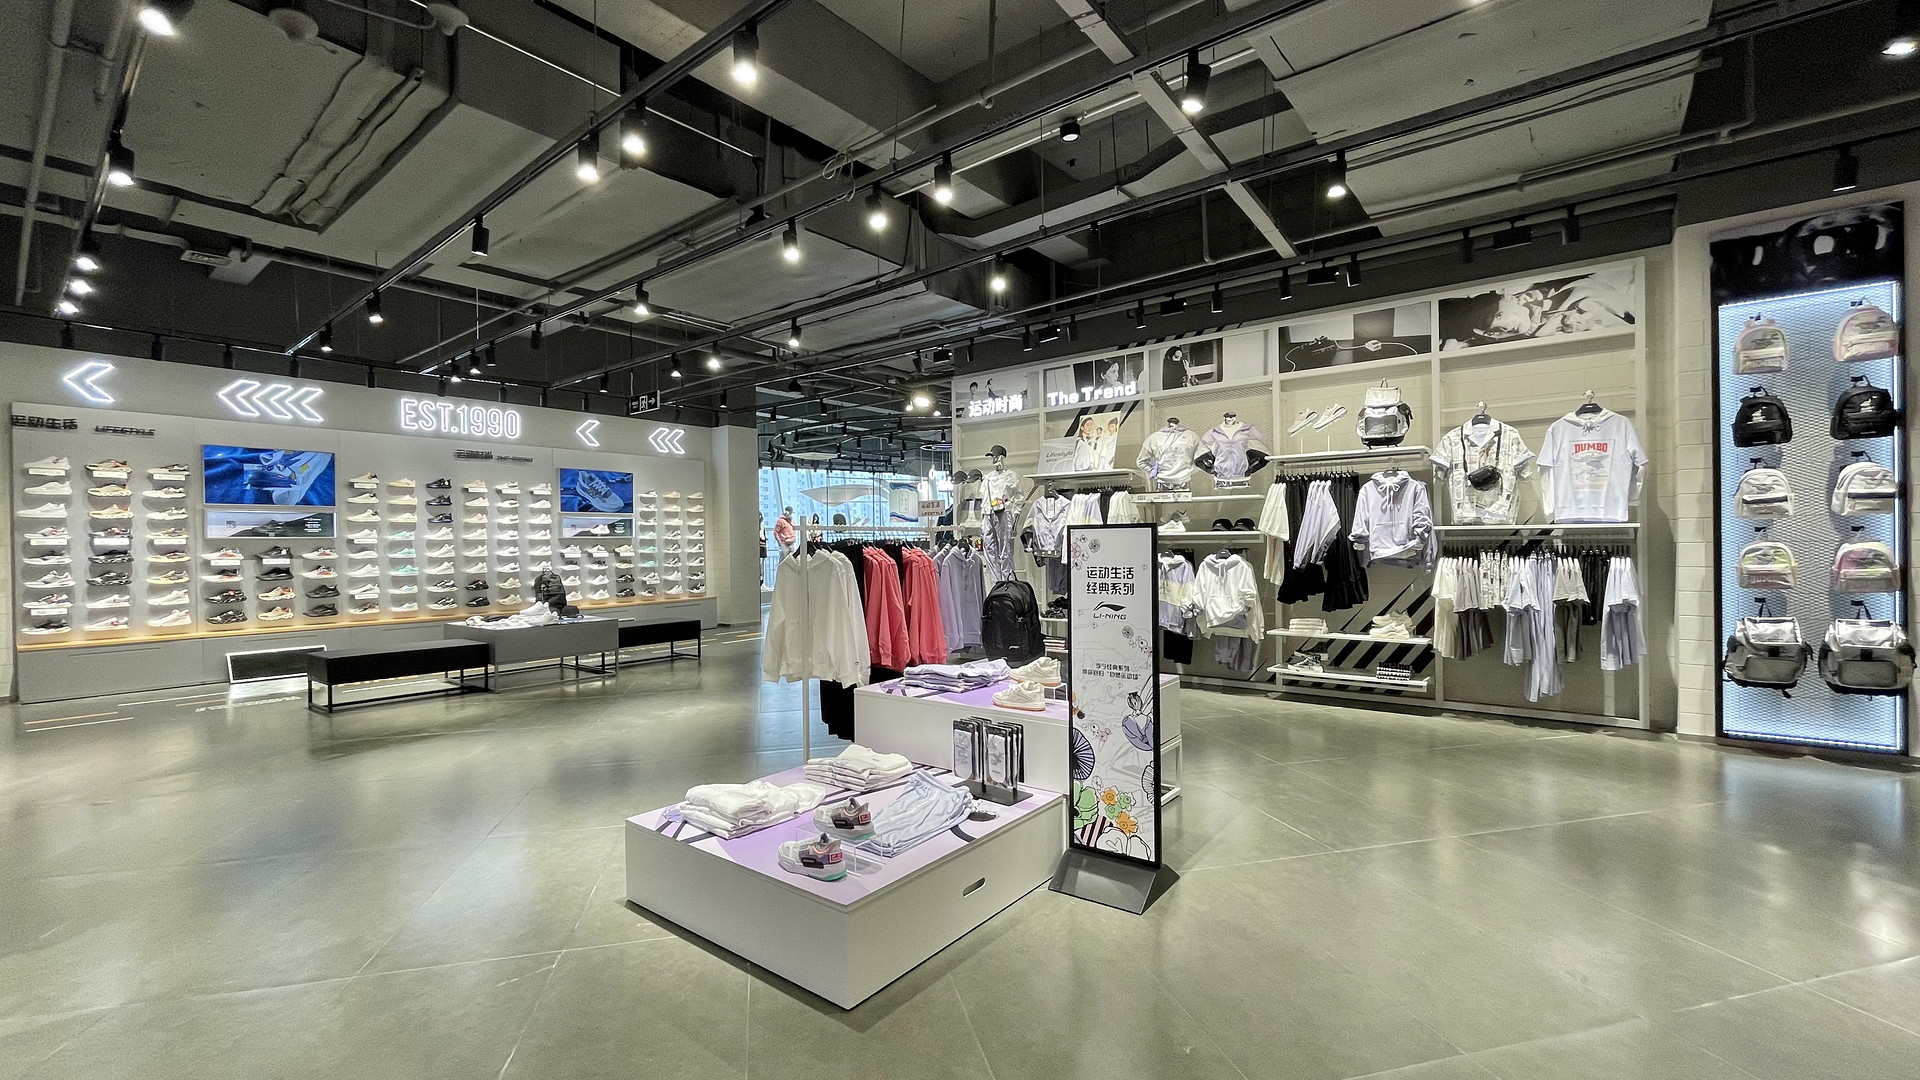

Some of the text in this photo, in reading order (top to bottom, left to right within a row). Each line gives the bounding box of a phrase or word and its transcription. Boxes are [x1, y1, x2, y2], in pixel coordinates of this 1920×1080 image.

[1047, 381, 1137, 407] The Trend
[968, 394, 1023, 418] 运动时尚
[400, 398, 521, 438] EST.1990
[1574, 442, 1608, 455] DUMBO
[1086, 566, 1134, 580] 运动生活
[1086, 581, 1135, 596] 经典系列
